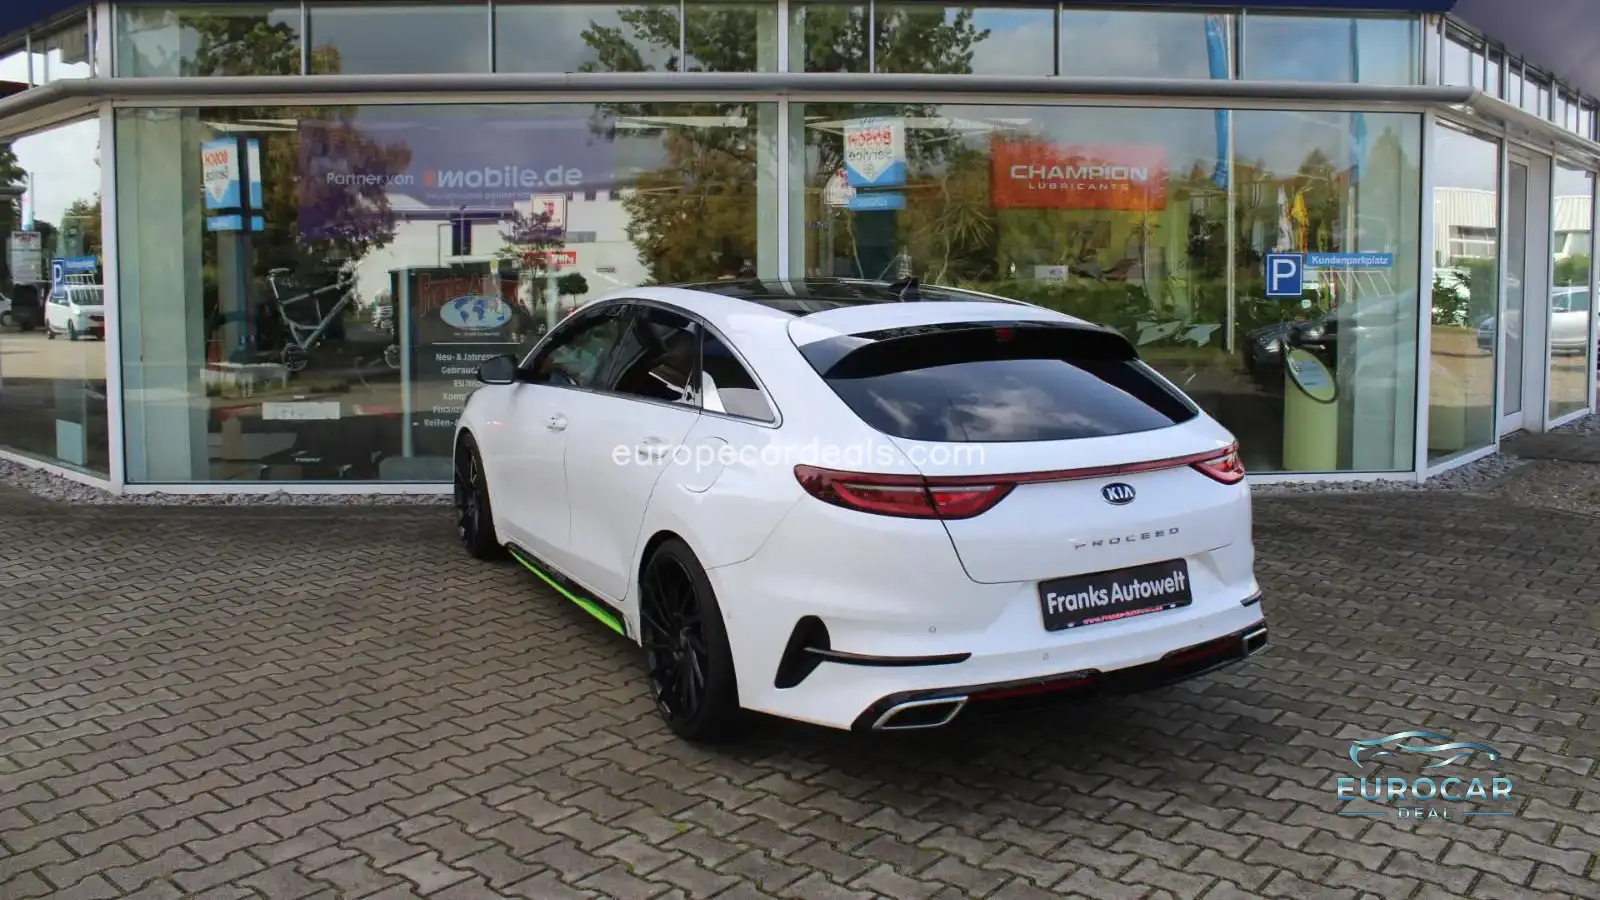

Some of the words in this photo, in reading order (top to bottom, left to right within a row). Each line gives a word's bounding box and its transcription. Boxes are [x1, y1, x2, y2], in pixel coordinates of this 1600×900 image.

[326, 171, 383, 187] Partner
[385, 174, 414, 187] von
[437, 165, 583, 188] mobile.de
[1010, 165, 1149, 181] CHAMPION
[1028, 182, 1130, 191] LUBRICANTS
[1311, 255, 1389, 267] Kundenparkplatz
[53, 263, 63, 294] P
[1272, 258, 1297, 291] P
[1106, 486, 1134, 501] KIA
[1047, 585, 1108, 614] Franks
[1111, 570, 1186, 604] Autowelt
